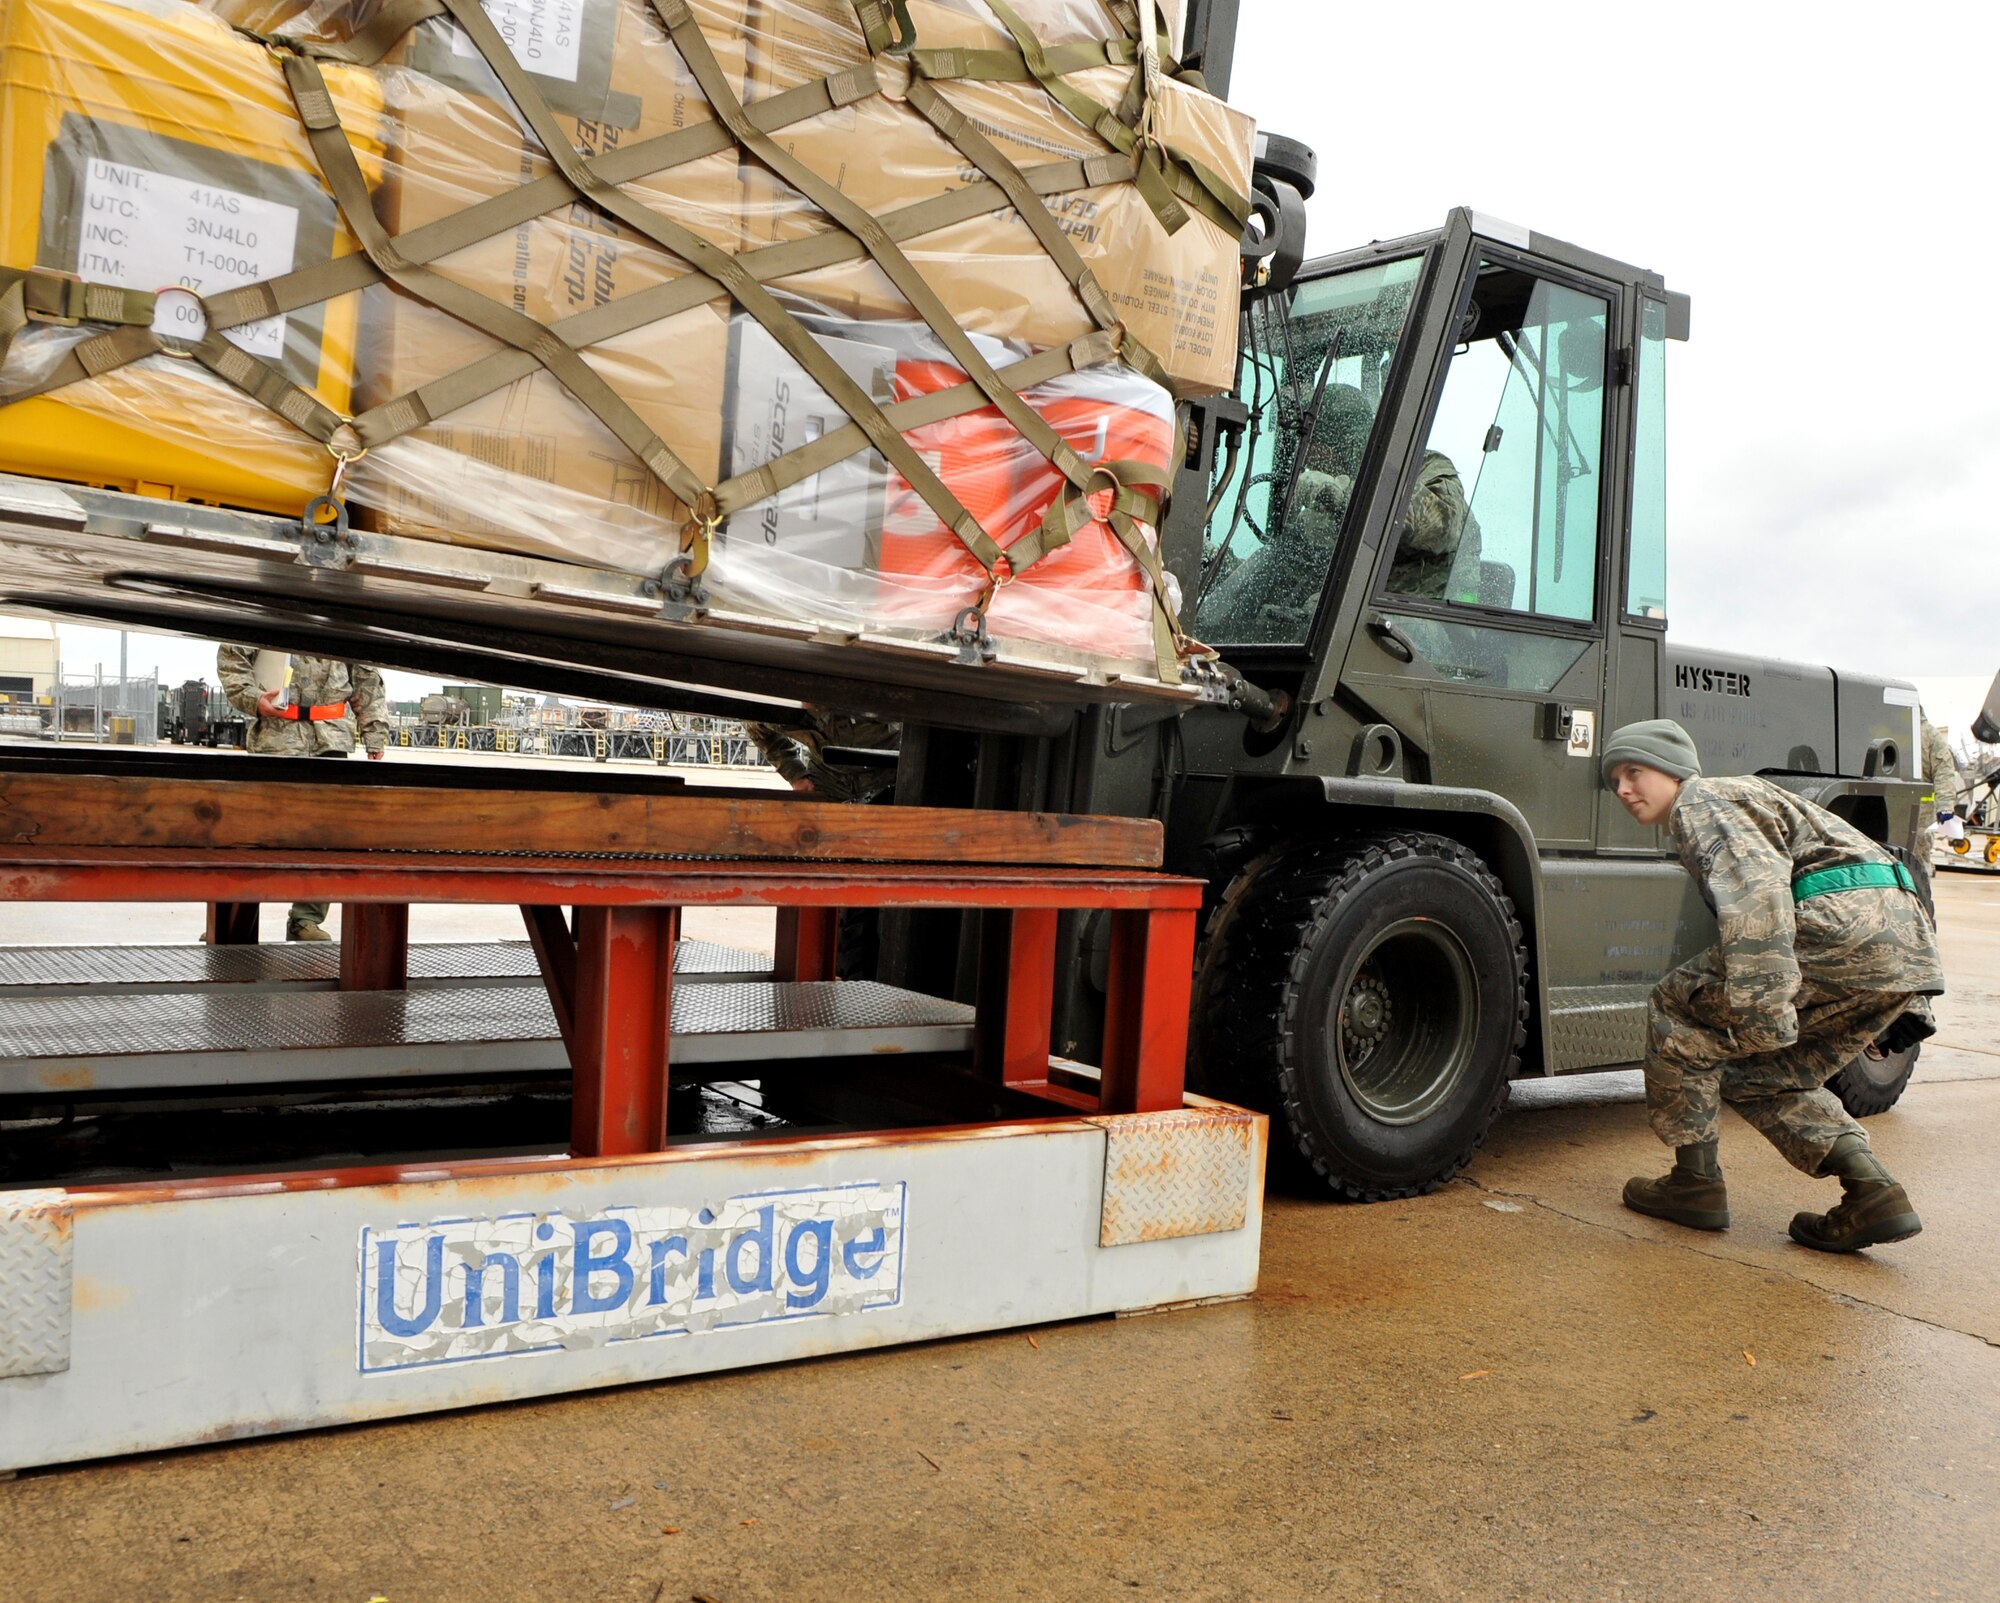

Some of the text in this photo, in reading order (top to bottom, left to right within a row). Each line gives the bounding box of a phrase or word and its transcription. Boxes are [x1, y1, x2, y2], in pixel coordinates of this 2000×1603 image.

[672, 92, 685, 128] CHAIR
[94, 162, 149, 191] UNIT:
[89, 193, 139, 220] UTC:
[189, 189, 241, 214] 41AS
[86, 223, 128, 248] INC:
[186, 217, 258, 248] 3NJ4L0
[81, 253, 126, 277] ITM:
[183, 245, 259, 278] T1-0004
[1111, 293, 1145, 310] FOLDING
[1148, 301, 1168, 316] STEEL
[268, 327, 279, 342] 4
[1675, 664, 1751, 697] HYSTER
[375, 1204, 900, 1338] UniBridge TM
